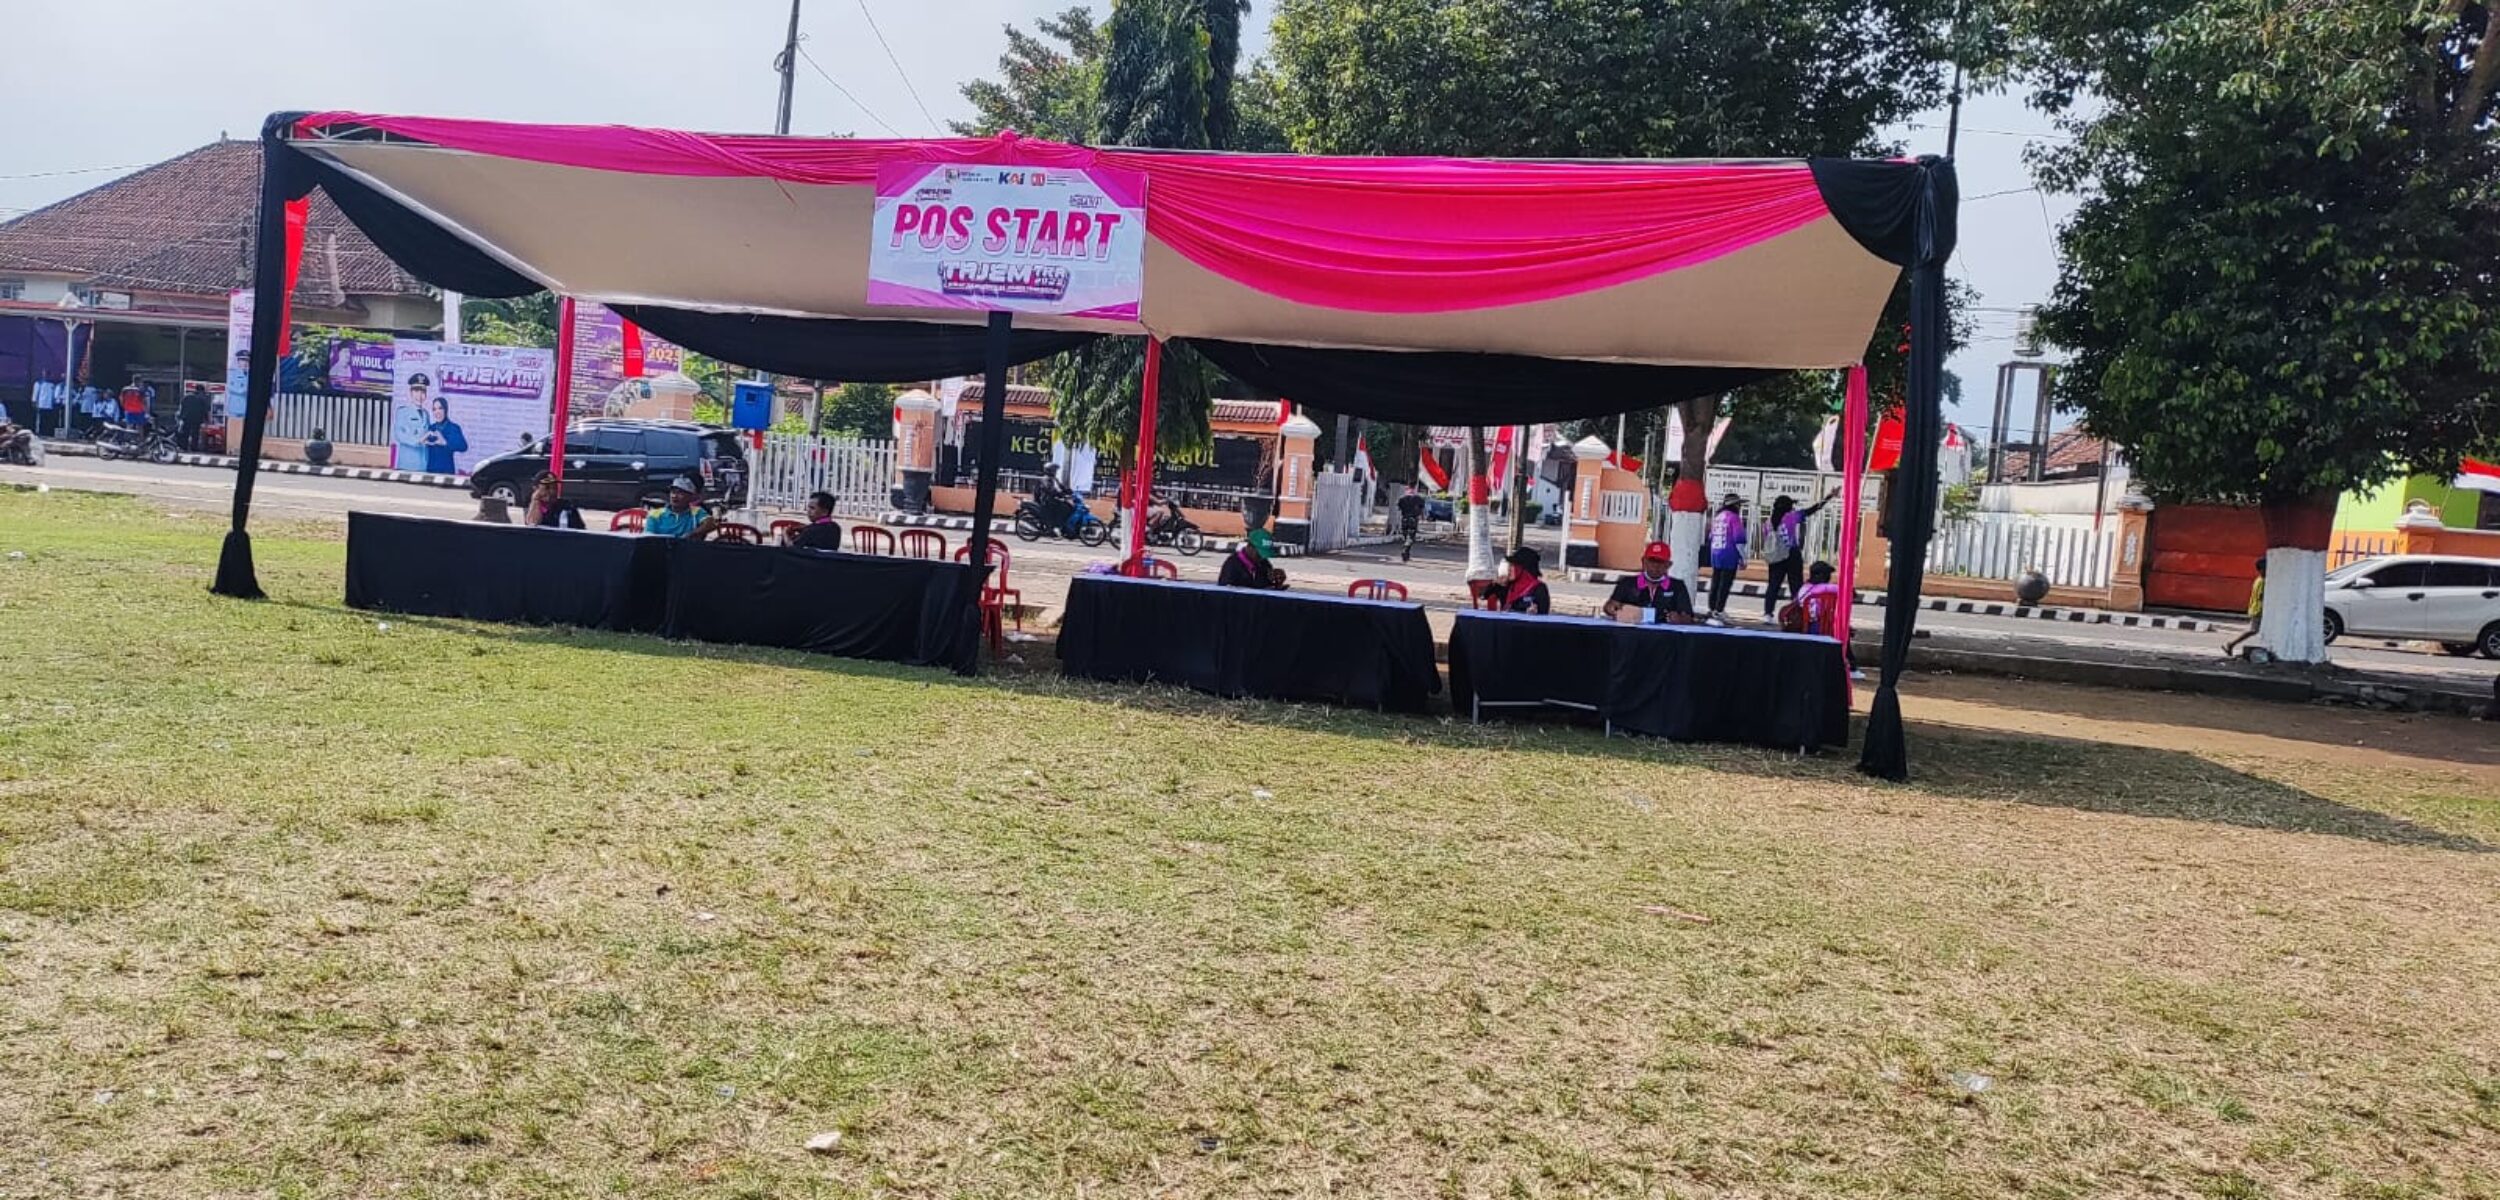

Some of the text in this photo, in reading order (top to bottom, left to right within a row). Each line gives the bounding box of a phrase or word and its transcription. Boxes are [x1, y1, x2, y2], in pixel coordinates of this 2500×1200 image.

[890, 204, 1122, 259] POS START
[351, 355, 383, 370] WADUL
